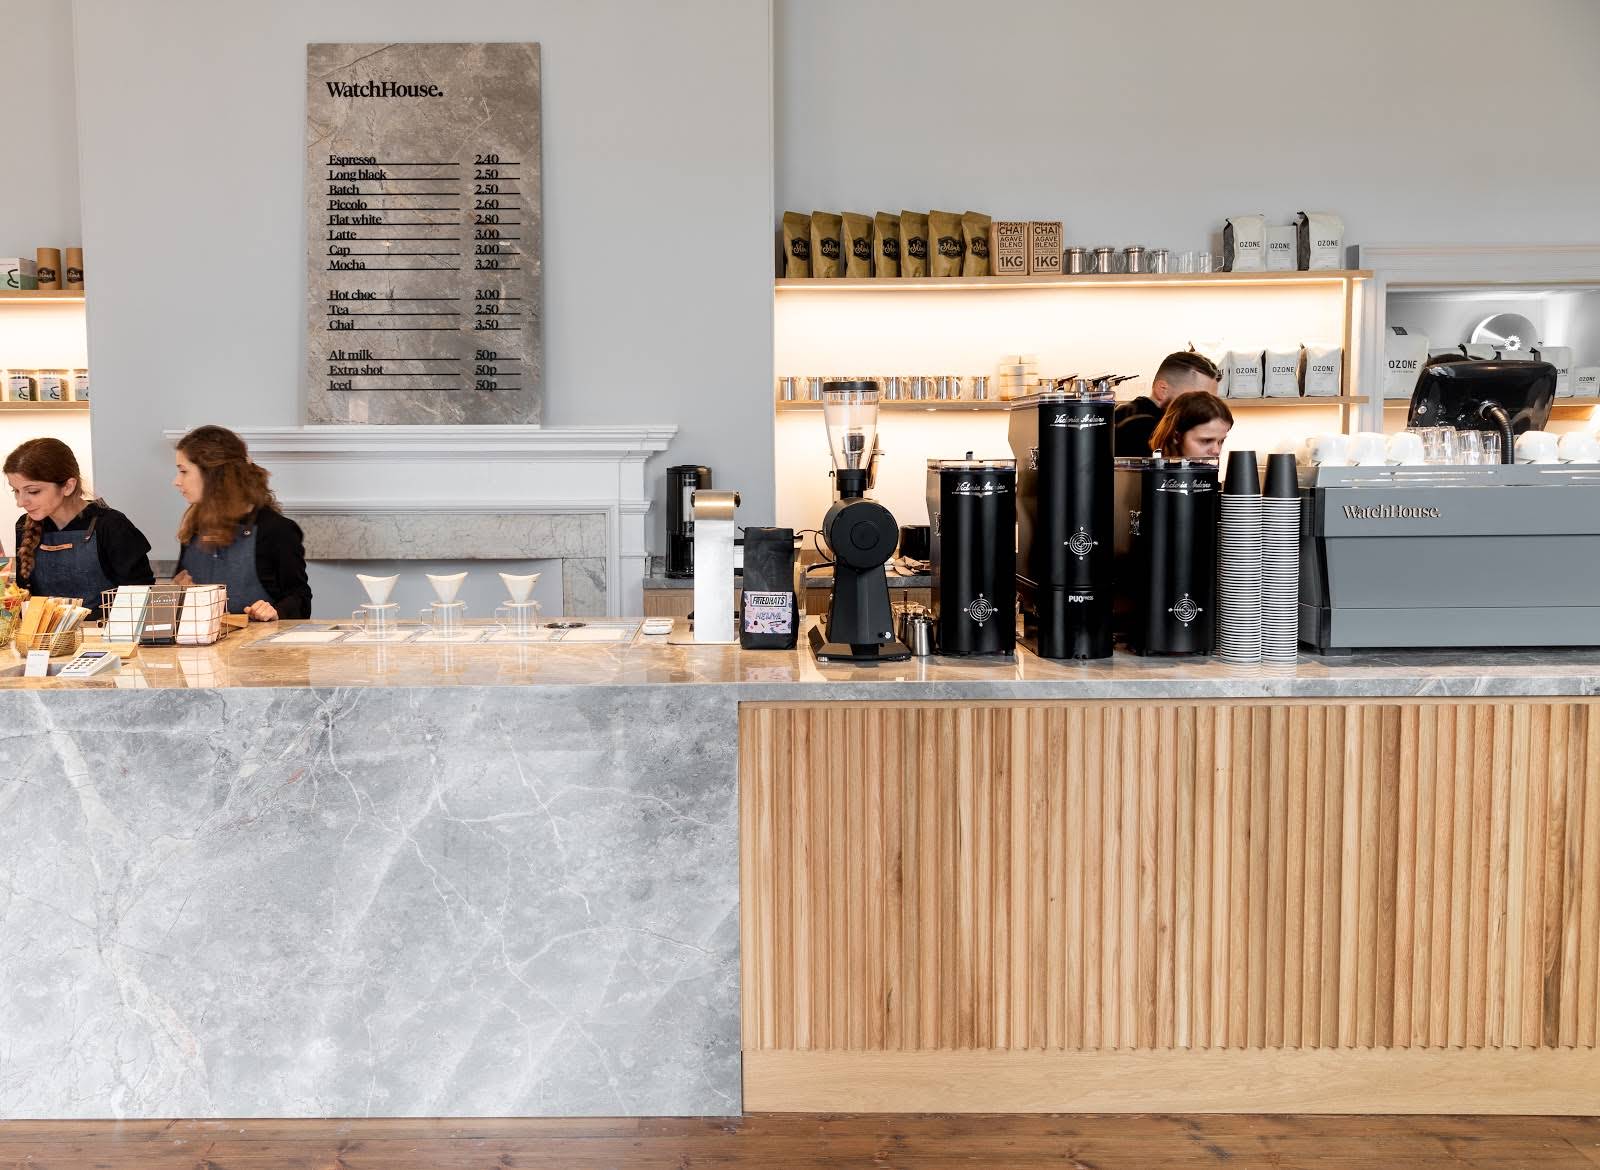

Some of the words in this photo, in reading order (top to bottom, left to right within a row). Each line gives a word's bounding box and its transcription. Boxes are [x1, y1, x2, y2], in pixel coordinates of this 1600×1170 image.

[327, 81, 444, 98] WatchHouse.
[329, 154, 377, 167] Espresso
[475, 154, 499, 165] 2.40
[329, 170, 357, 182] Long
[358, 169, 387, 180] black
[475, 169, 499, 180] 2.50
[329, 184, 360, 195] Batch
[475, 184, 499, 195] 2.50
[329, 199, 368, 210] Piccolo
[475, 199, 499, 210] 2.60
[329, 213, 350, 225] Flat
[352, 213, 382, 225] white
[475, 214, 499, 225] 2.80
[329, 229, 357, 240] Latte
[475, 229, 500, 240] 3.00
[1000, 226, 1023, 235] CHAI
[1035, 226, 1058, 235] CHAI
[329, 245, 351, 257] Cap
[475, 244, 500, 255] 3.00
[329, 259, 366, 270] Mocha
[475, 259, 499, 270] 3.20
[1000, 256, 1023, 267] 1KG
[1035, 256, 1058, 267] 1KG
[329, 289, 349, 300] Hot
[351, 289, 377, 300] choc
[475, 289, 500, 300] 3.00
[329, 304, 349, 315] Tea
[475, 304, 499, 315] 2.50
[329, 319, 354, 330] Chai
[475, 319, 499, 330] 3.50
[329, 349, 346, 360] Alt
[348, 349, 373, 360] milk
[475, 349, 497, 361] 50p
[329, 365, 359, 376] Extra
[360, 365, 384, 375] shot
[475, 364, 497, 376] 50p
[1388, 360, 1418, 369] OZONE
[329, 380, 352, 391] Iced
[475, 379, 497, 392] 50p
[1342, 504, 1442, 519] WatchHouse.
[752, 596, 786, 605] FRIEDHATS
